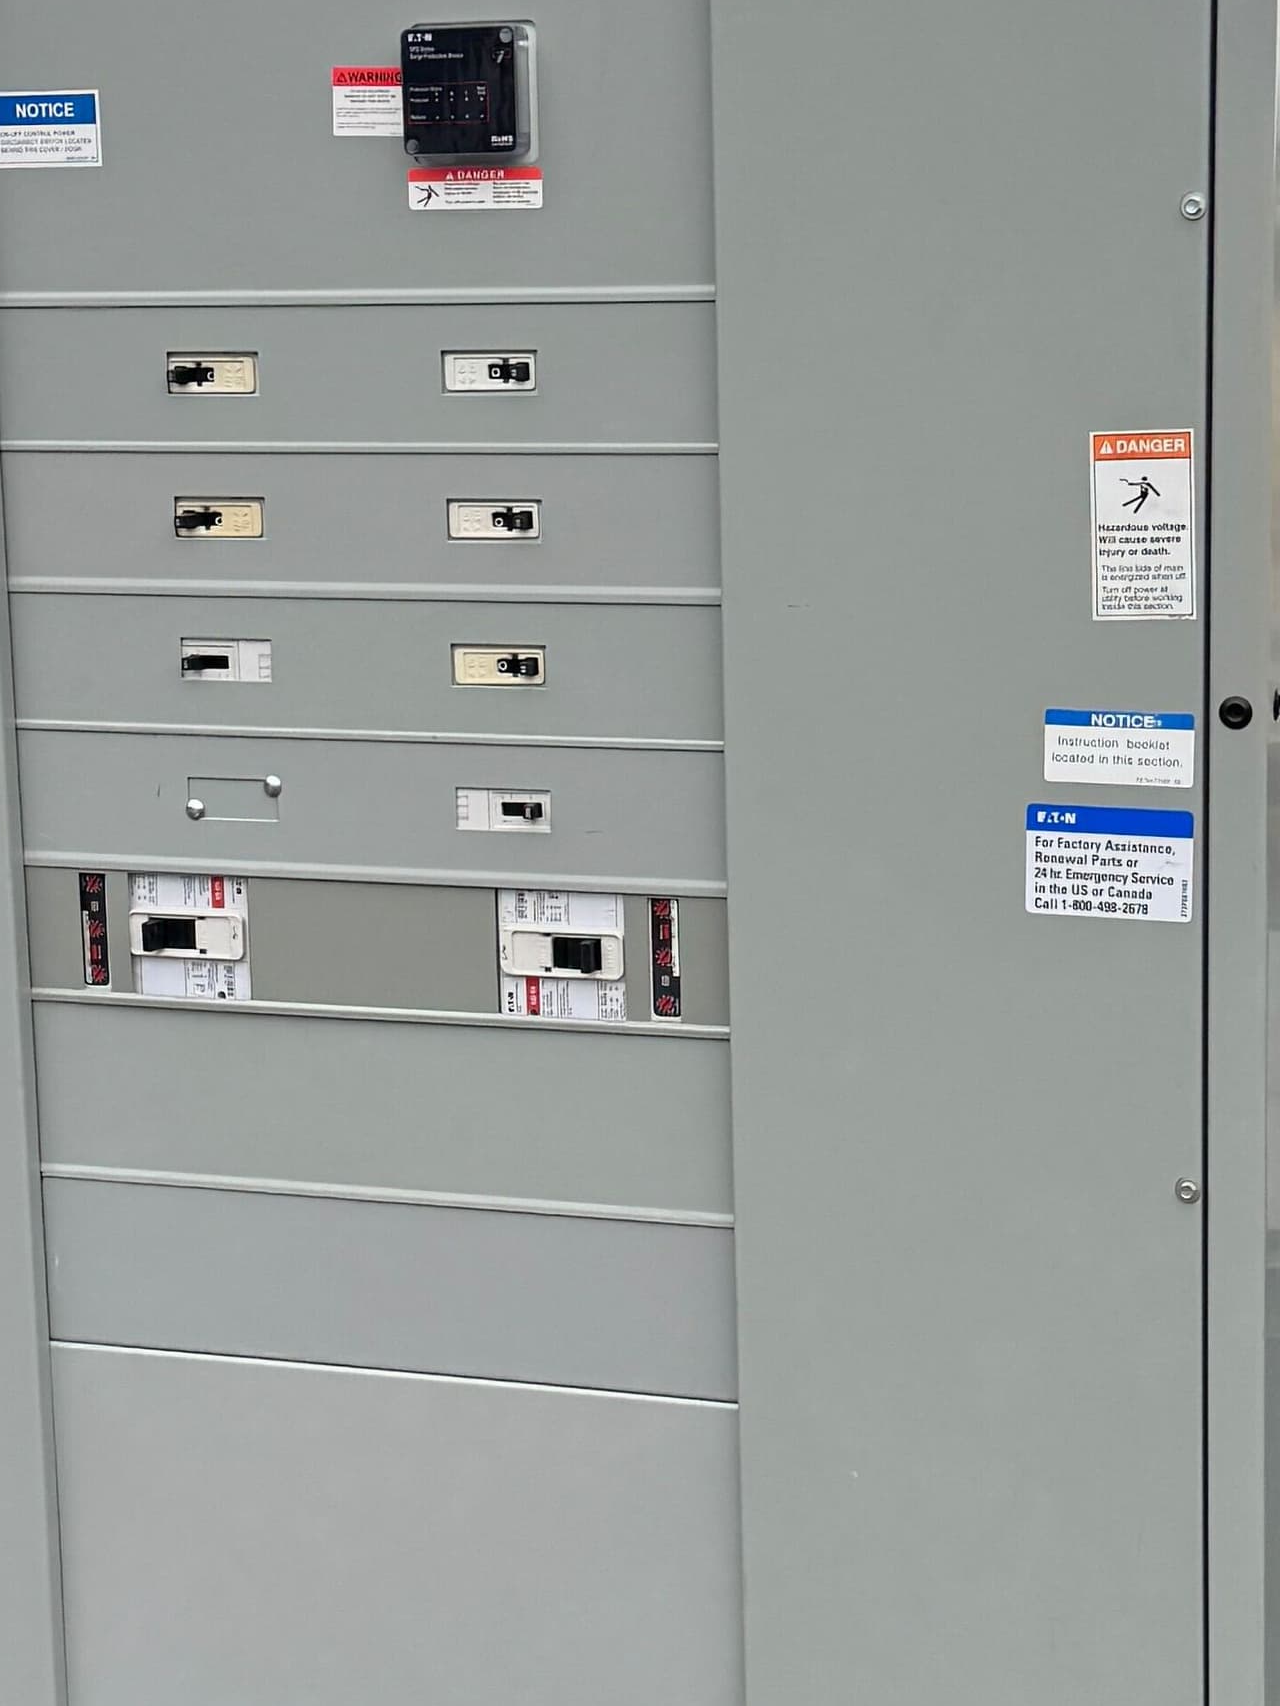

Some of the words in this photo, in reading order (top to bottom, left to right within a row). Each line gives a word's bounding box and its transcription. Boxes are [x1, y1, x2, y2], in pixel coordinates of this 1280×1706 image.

[348, 72, 402, 83] WARNING
[15, 102, 75, 119] NOTICE
[457, 170, 505, 180] DANGER
[1116, 438, 1186, 454] DANGER
[1098, 523, 1149, 532] Hazardous
[1098, 536, 1116, 544] Will
[1141, 547, 1171, 556] death.
[1101, 564, 1117, 572] The
[1153, 564, 1163, 572] of
[1091, 713, 1155, 728] NOTICE
[1058, 736, 1120, 749] Instruction
[1126, 739, 1170, 751] booklet
[1051, 752, 1095, 765] located
[1099, 754, 1109, 765] in
[1112, 754, 1133, 766] this
[1137, 756, 1183, 768] section.
[1037, 810, 1077, 825] EATON
[1034, 836, 1055, 848] For
[1057, 837, 1102, 853] Factory
[1104, 839, 1176, 857] Assistance,
[1034, 851, 1088, 865] Renewal
[1091, 854, 1123, 867] Parts
[1126, 858, 1139, 868] or
[1034, 867, 1047, 879] 24
[1065, 869, 1128, 885] Emergency
[1131, 872, 1175, 886] Service
[1034, 882, 1046, 894] in
[1049, 883, 1068, 895] the
[1071, 884, 1088, 896] US
[1091, 887, 1104, 897] or
[1107, 886, 1153, 900] Canada
[1034, 897, 1058, 910] Call
